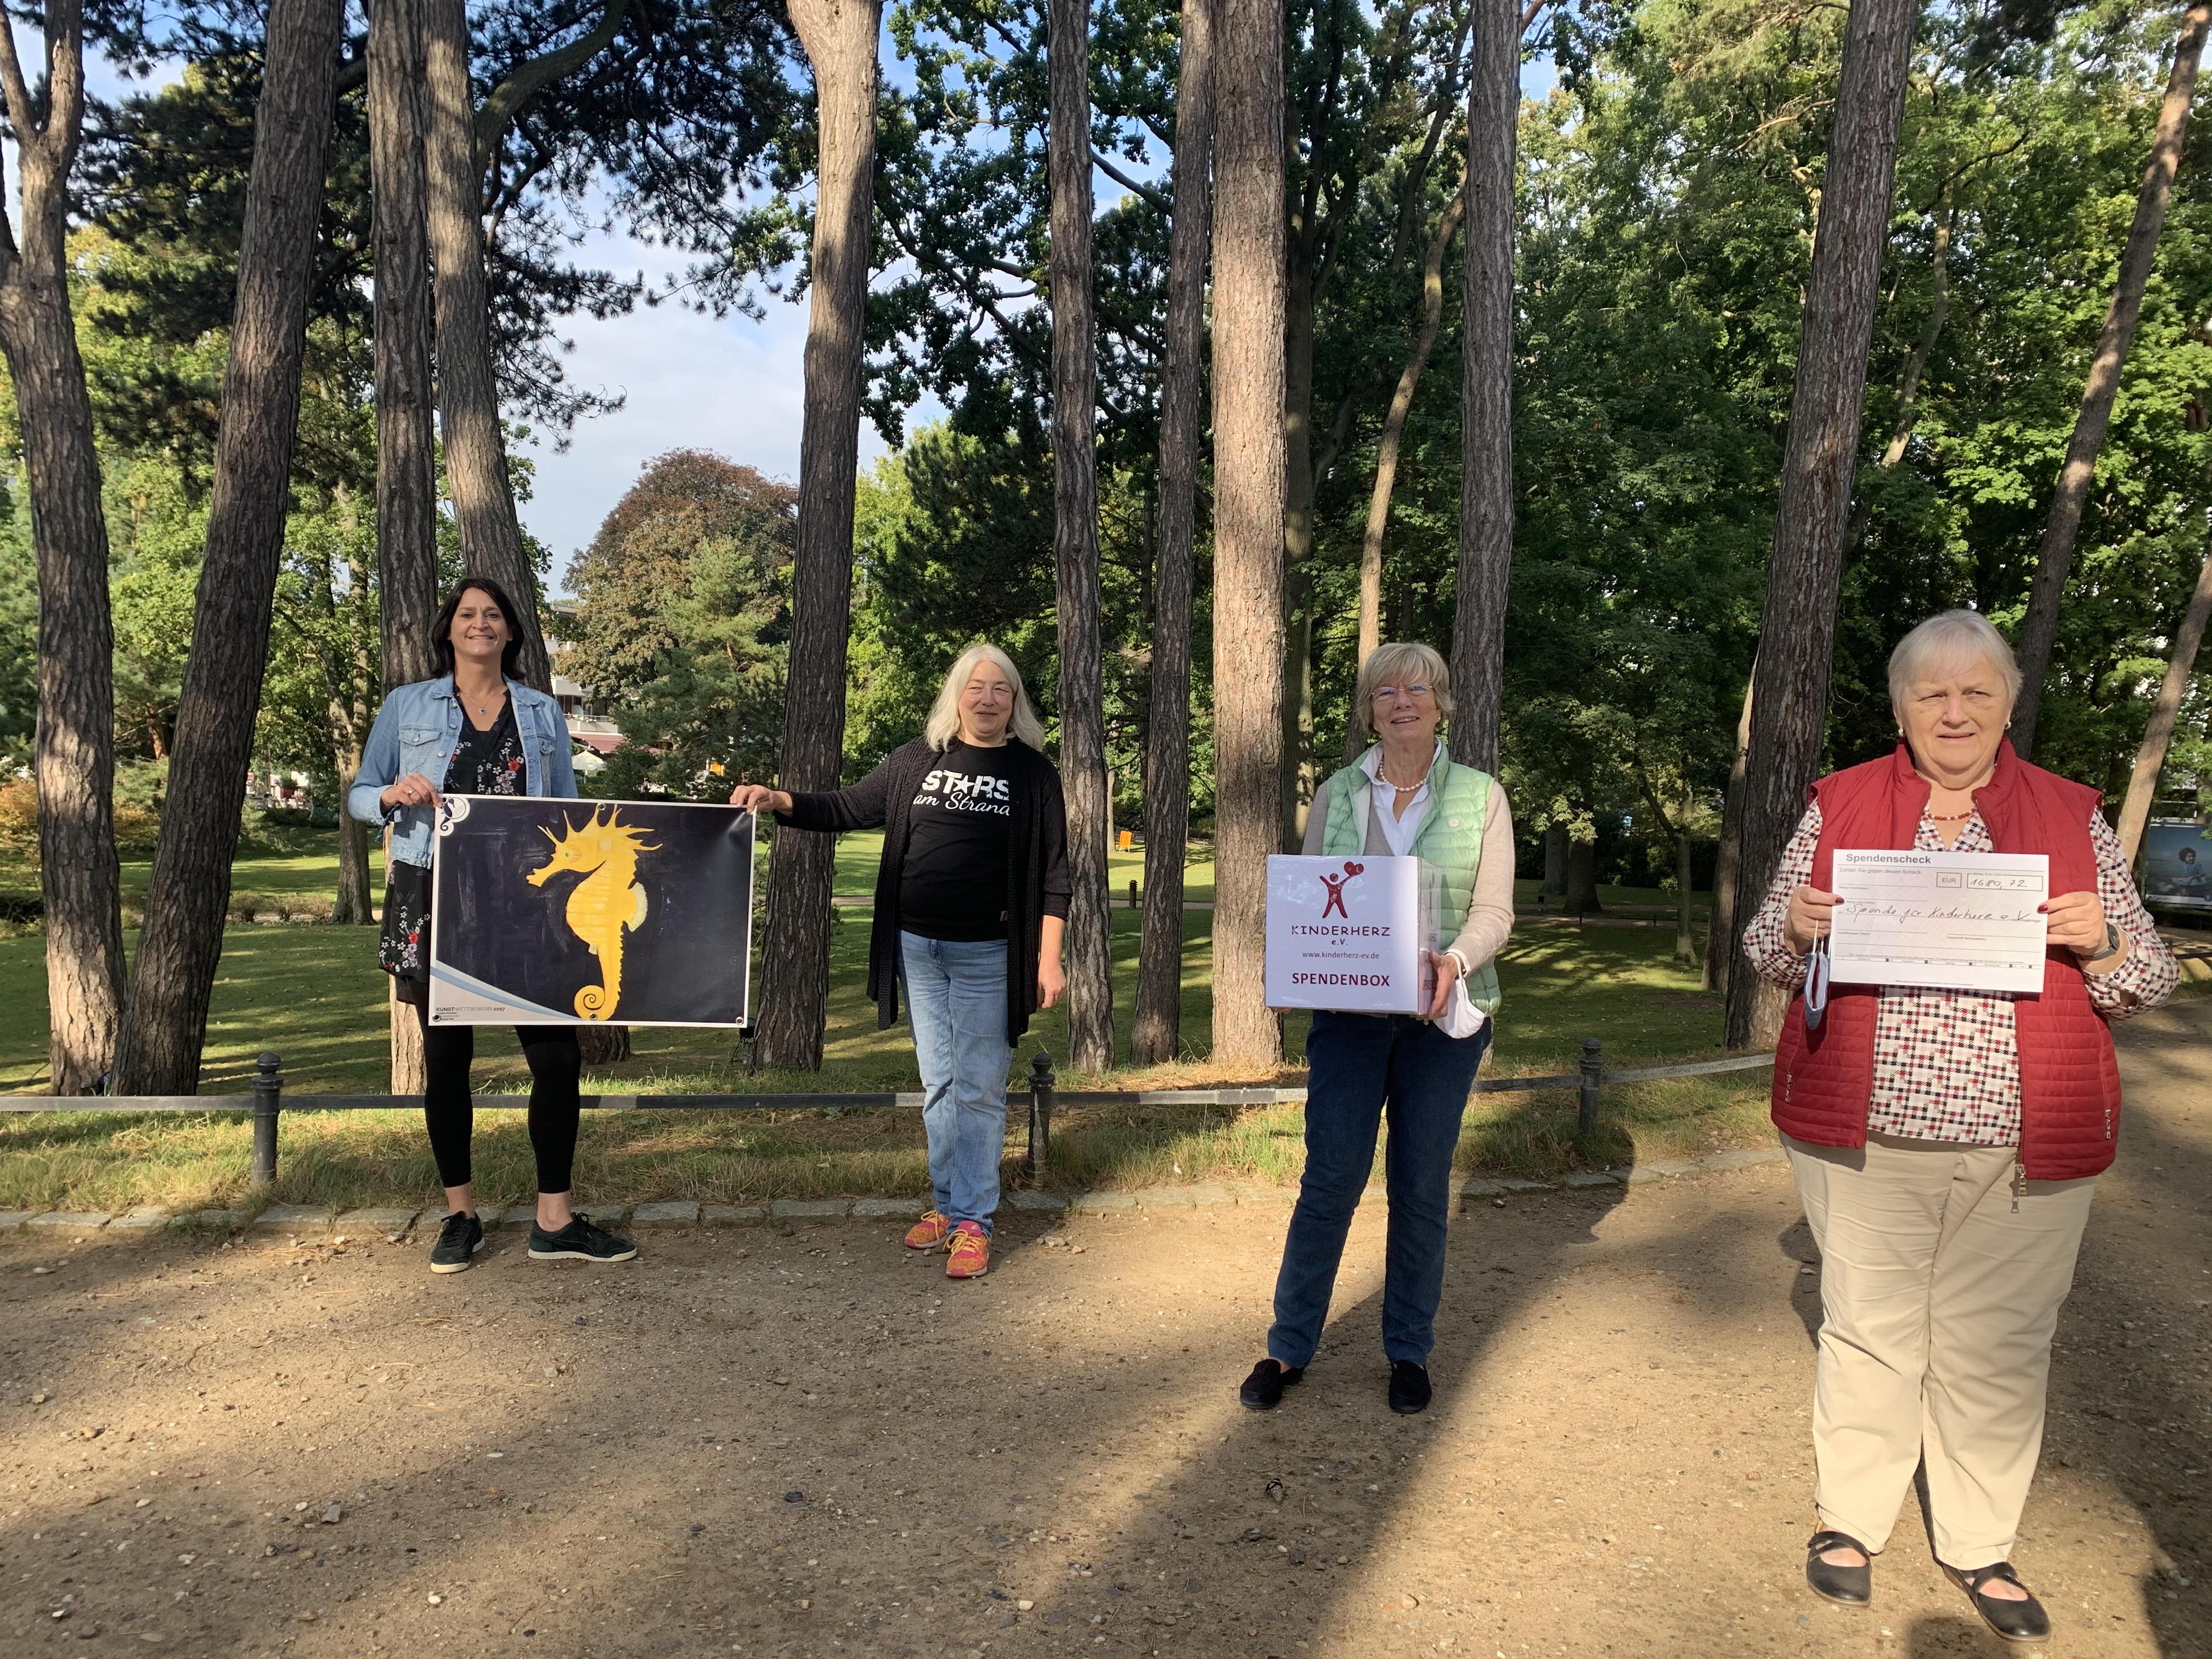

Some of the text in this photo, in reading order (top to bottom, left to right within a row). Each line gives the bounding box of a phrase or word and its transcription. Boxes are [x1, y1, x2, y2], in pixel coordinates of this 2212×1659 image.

[913, 794, 940, 806] am
[1846, 854, 1932, 864] Spendenscheck
[1291, 925, 1391, 936] KINDERHERZ
[1292, 973, 1390, 986] SPENDENBOX
